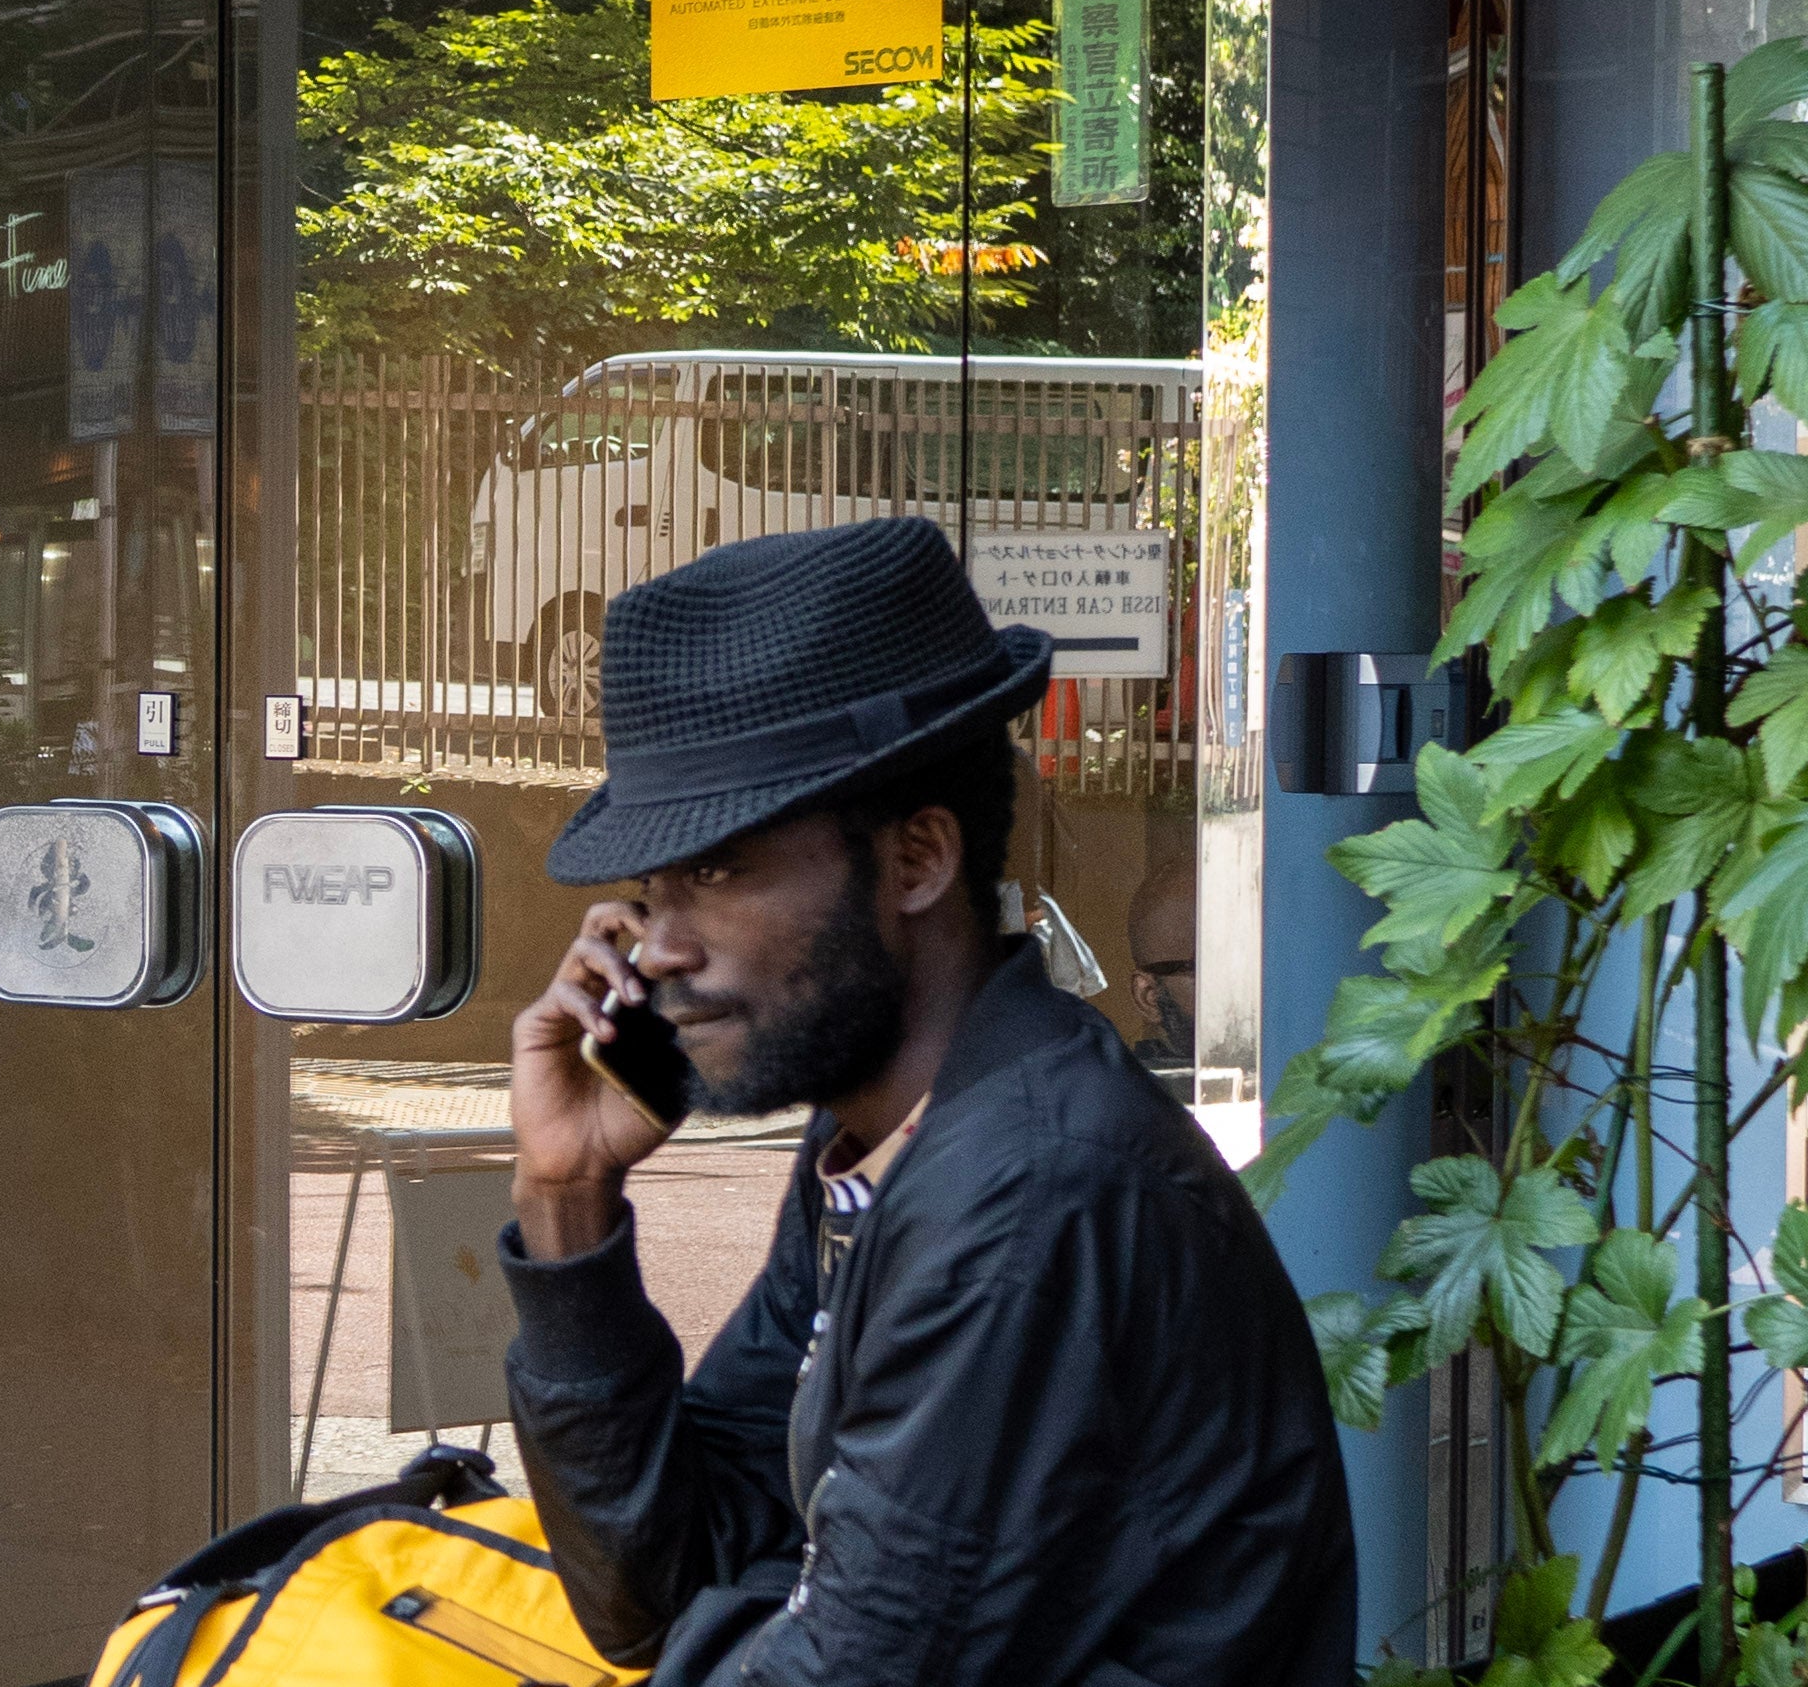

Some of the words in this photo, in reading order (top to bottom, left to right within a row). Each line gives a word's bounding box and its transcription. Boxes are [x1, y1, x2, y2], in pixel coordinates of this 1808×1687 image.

[844, 44, 934, 76] SECOM
[145, 700, 163, 724] 引
[273, 701, 292, 735] 締切
[143, 739, 166, 748] PULL
[268, 743, 295, 753] CLOSED
[262, 861, 395, 907] FWEAP
